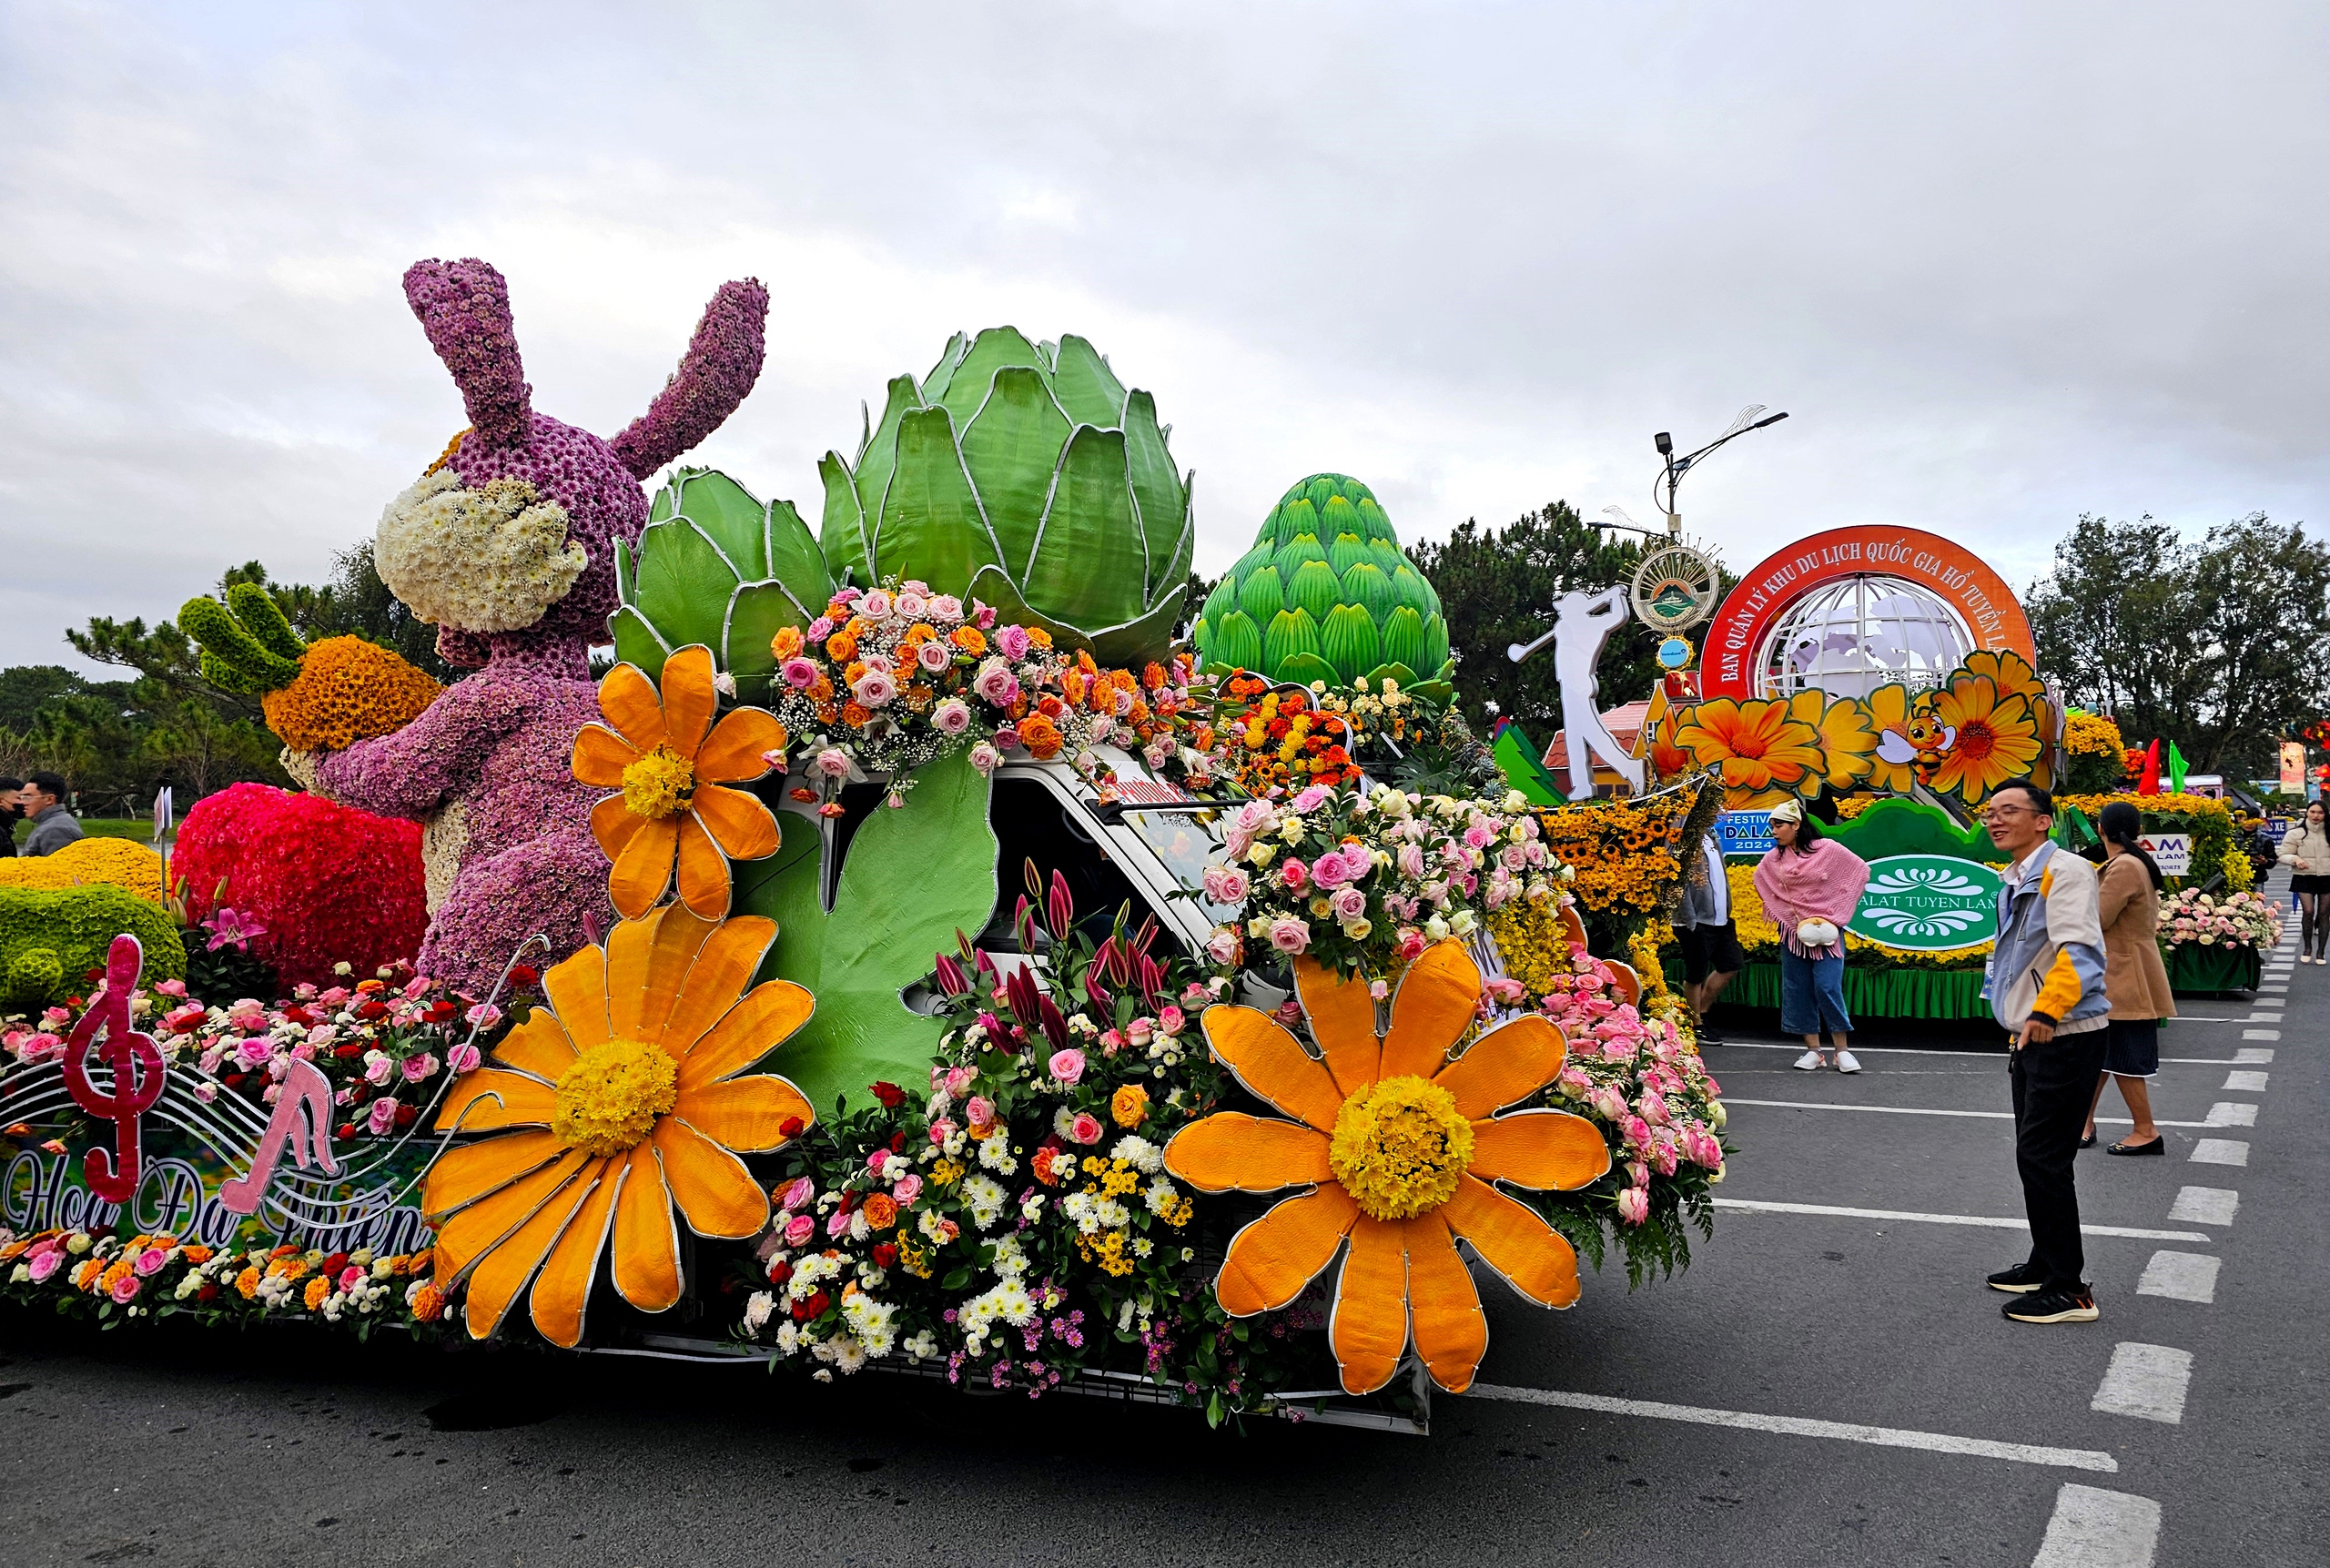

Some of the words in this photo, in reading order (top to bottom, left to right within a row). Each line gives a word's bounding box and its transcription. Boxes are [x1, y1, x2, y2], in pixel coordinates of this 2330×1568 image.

[1795, 551, 1819, 574] DU
[1821, 542, 1861, 566] LỊCH
[1866, 538, 1912, 563] QUỐC
[1913, 551, 1941, 576] GIA
[1762, 563, 1797, 595] KHU
[1746, 587, 1768, 612] LÝ
[1726, 609, 1756, 649] QUẢN
[1721, 652, 1739, 683] BAN
[1725, 825, 1775, 839] DALA
[1857, 895, 1900, 907] ALAT
[1906, 896, 1960, 908] TUYEN
